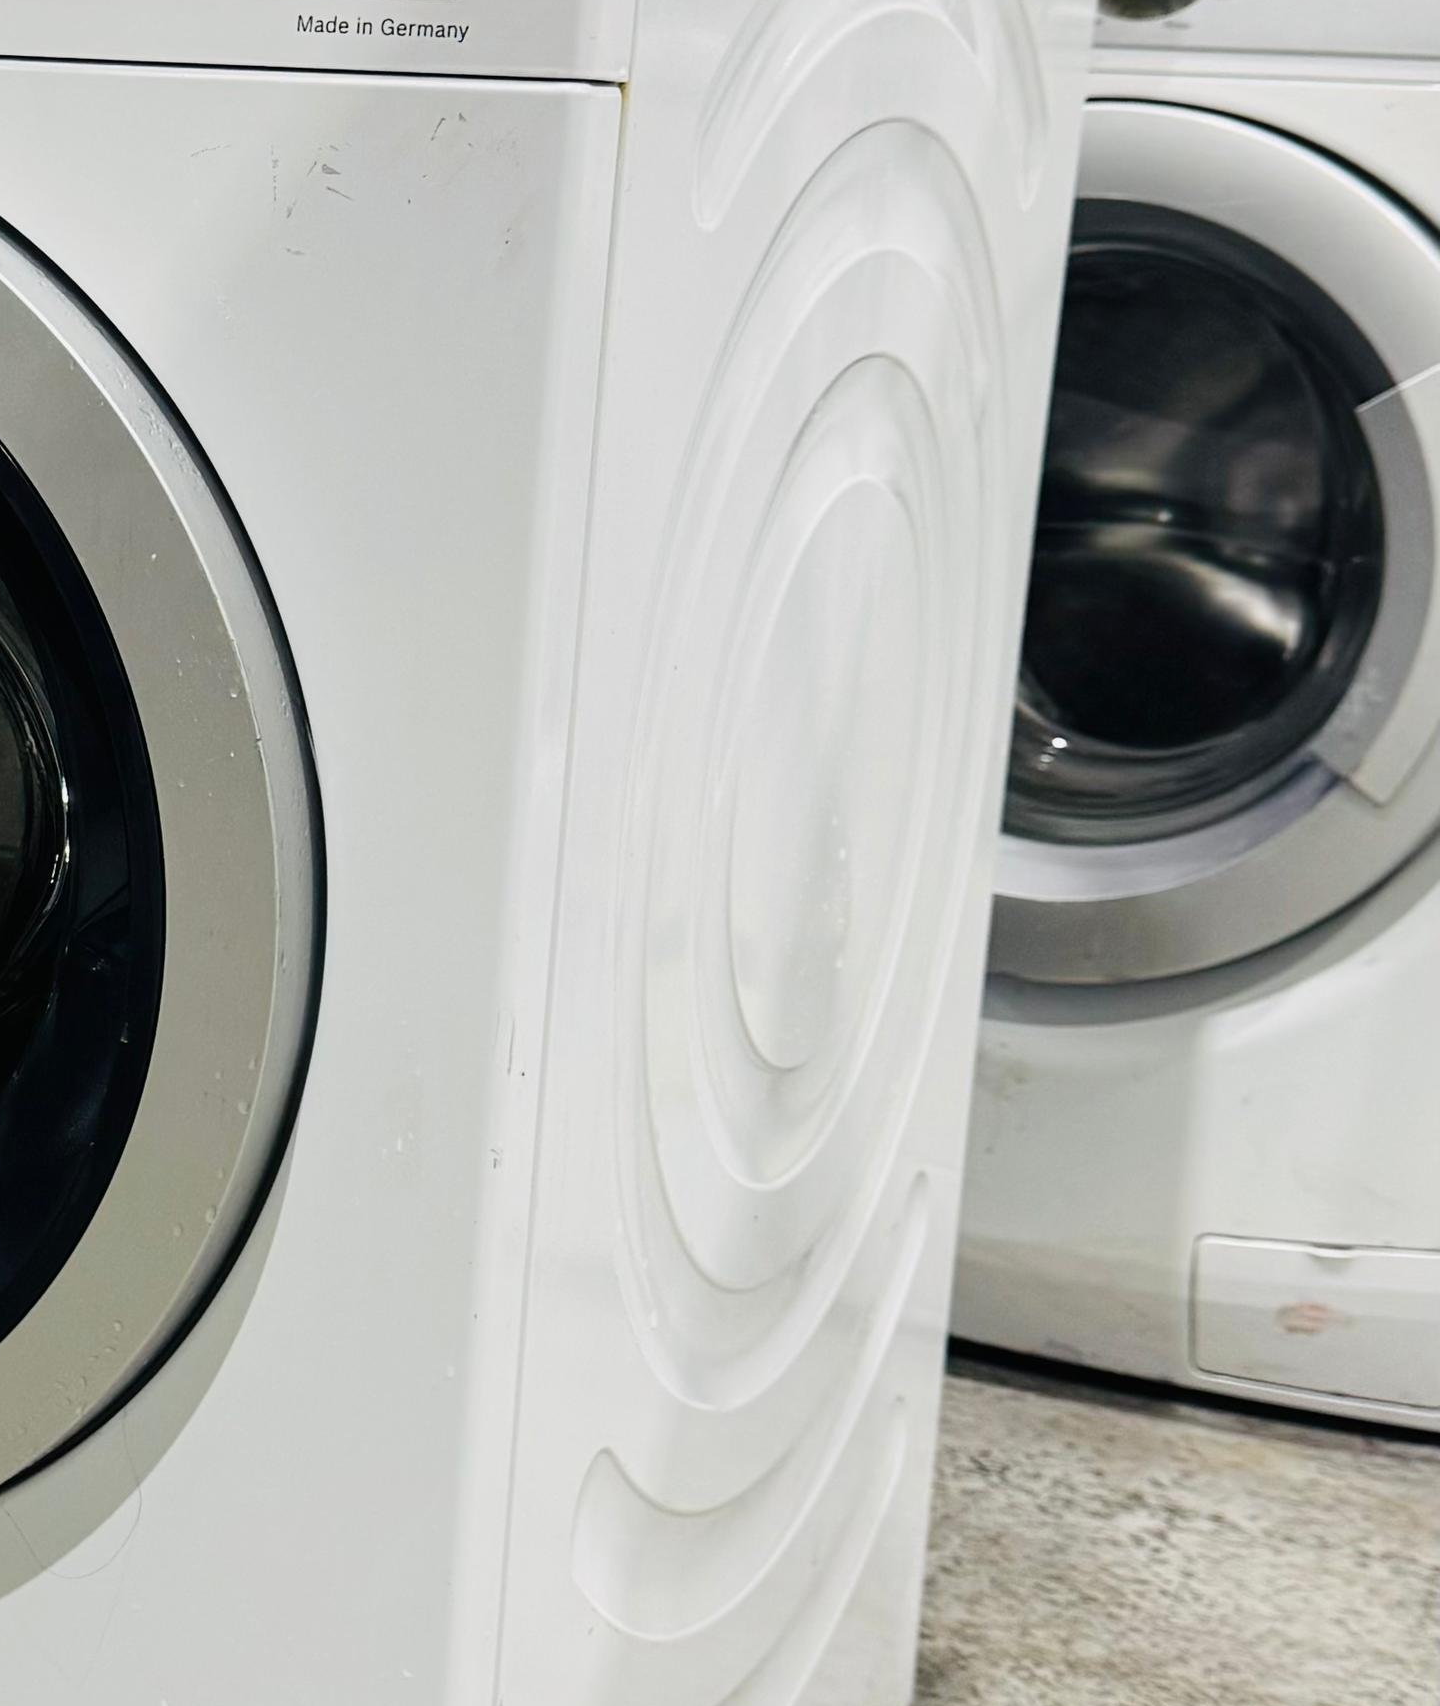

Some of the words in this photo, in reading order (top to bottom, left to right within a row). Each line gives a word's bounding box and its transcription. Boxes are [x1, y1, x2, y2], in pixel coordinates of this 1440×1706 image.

[297, 14, 350, 36] Made
[356, 15, 373, 35] in
[380, 17, 469, 43] Germany
